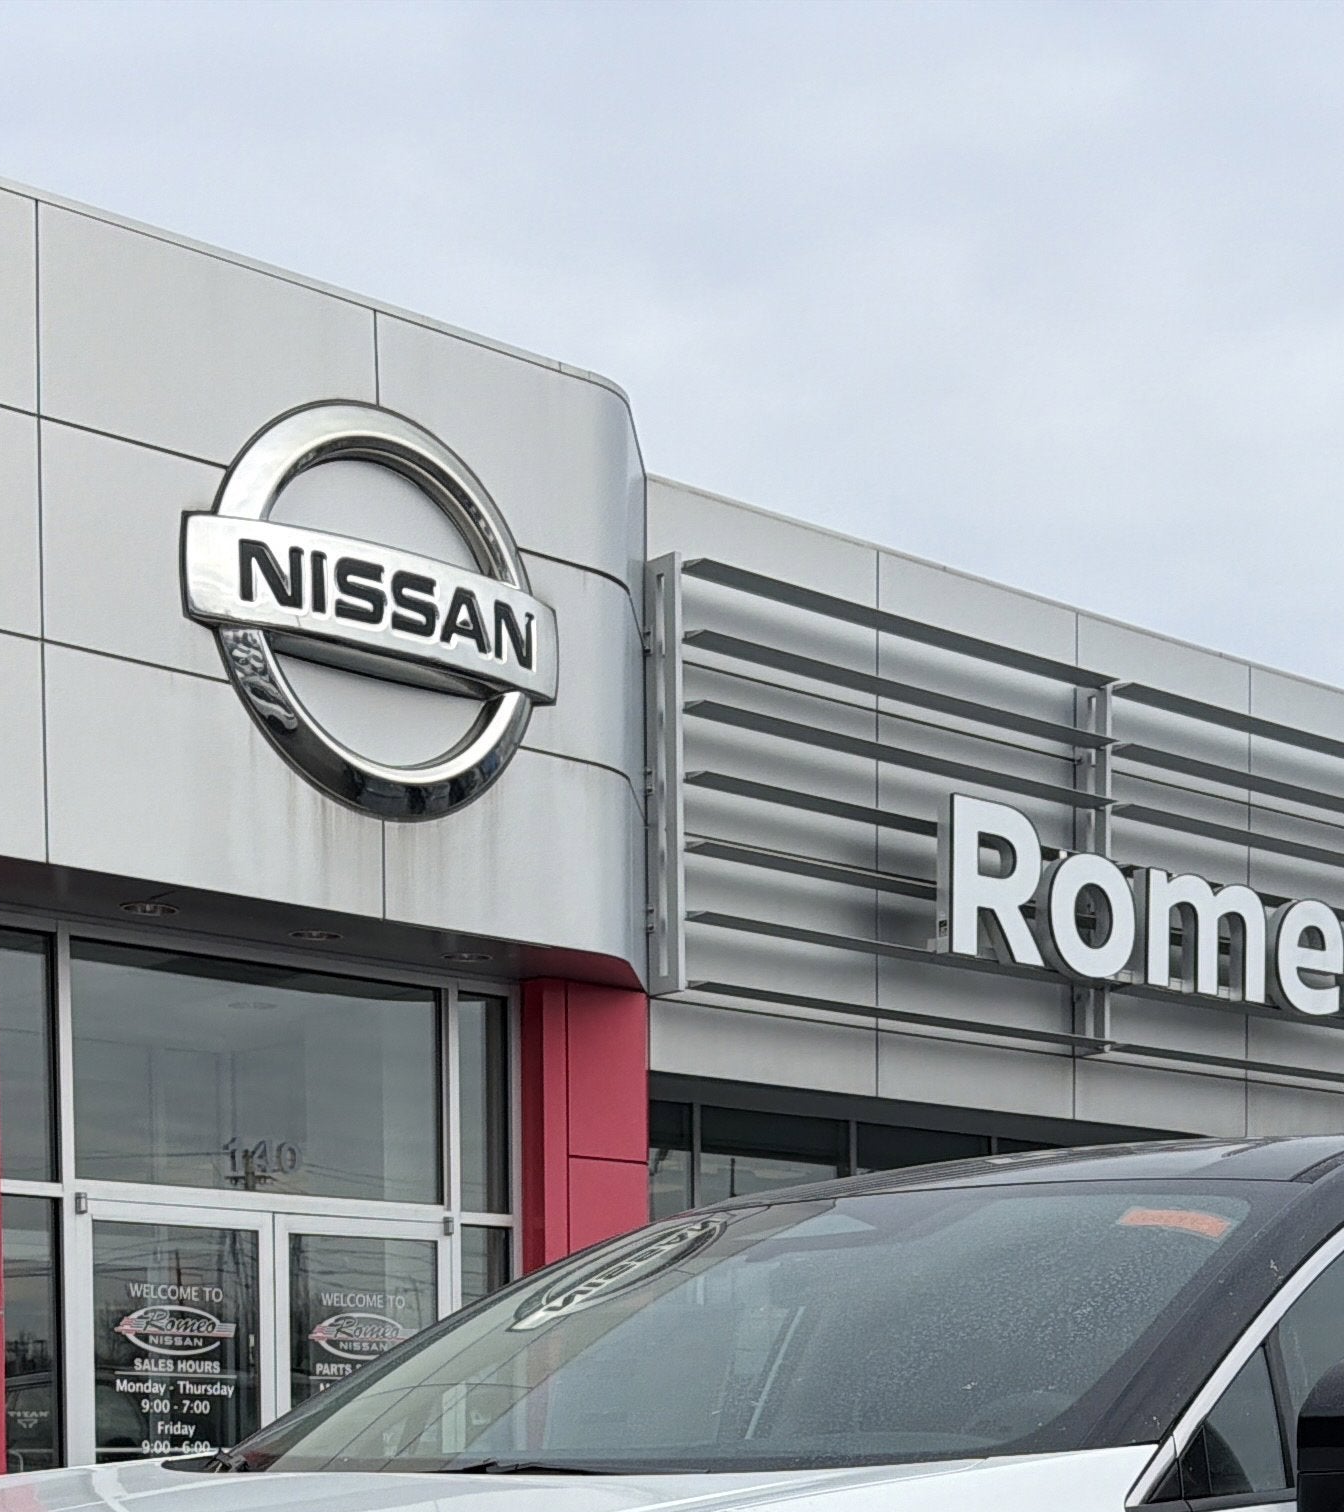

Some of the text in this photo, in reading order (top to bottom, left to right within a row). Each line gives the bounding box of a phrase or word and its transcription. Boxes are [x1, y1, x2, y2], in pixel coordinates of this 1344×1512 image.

[238, 538, 535, 671] NISSAN
[222, 1136, 302, 1174] 140
[129, 1282, 223, 1302] WELCOME TO
[321, 1292, 406, 1309] WELCOME TO
[141, 1308, 217, 1334] Romeo
[332, 1315, 400, 1339] Romeo
[148, 1335, 204, 1347] NISSAN
[339, 1341, 388, 1352] NISSAN
[133, 1358, 221, 1374] SALES HOURS
[316, 1363, 352, 1376] PARTS
[115, 1379, 166, 1396] Monday
[177, 1380, 235, 1398] Thursday
[141, 1399, 170, 1413] 9:00
[182, 1400, 210, 1414] 7:00
[157, 1421, 196, 1438] Friday
[141, 1440, 170, 1454] 9:00
